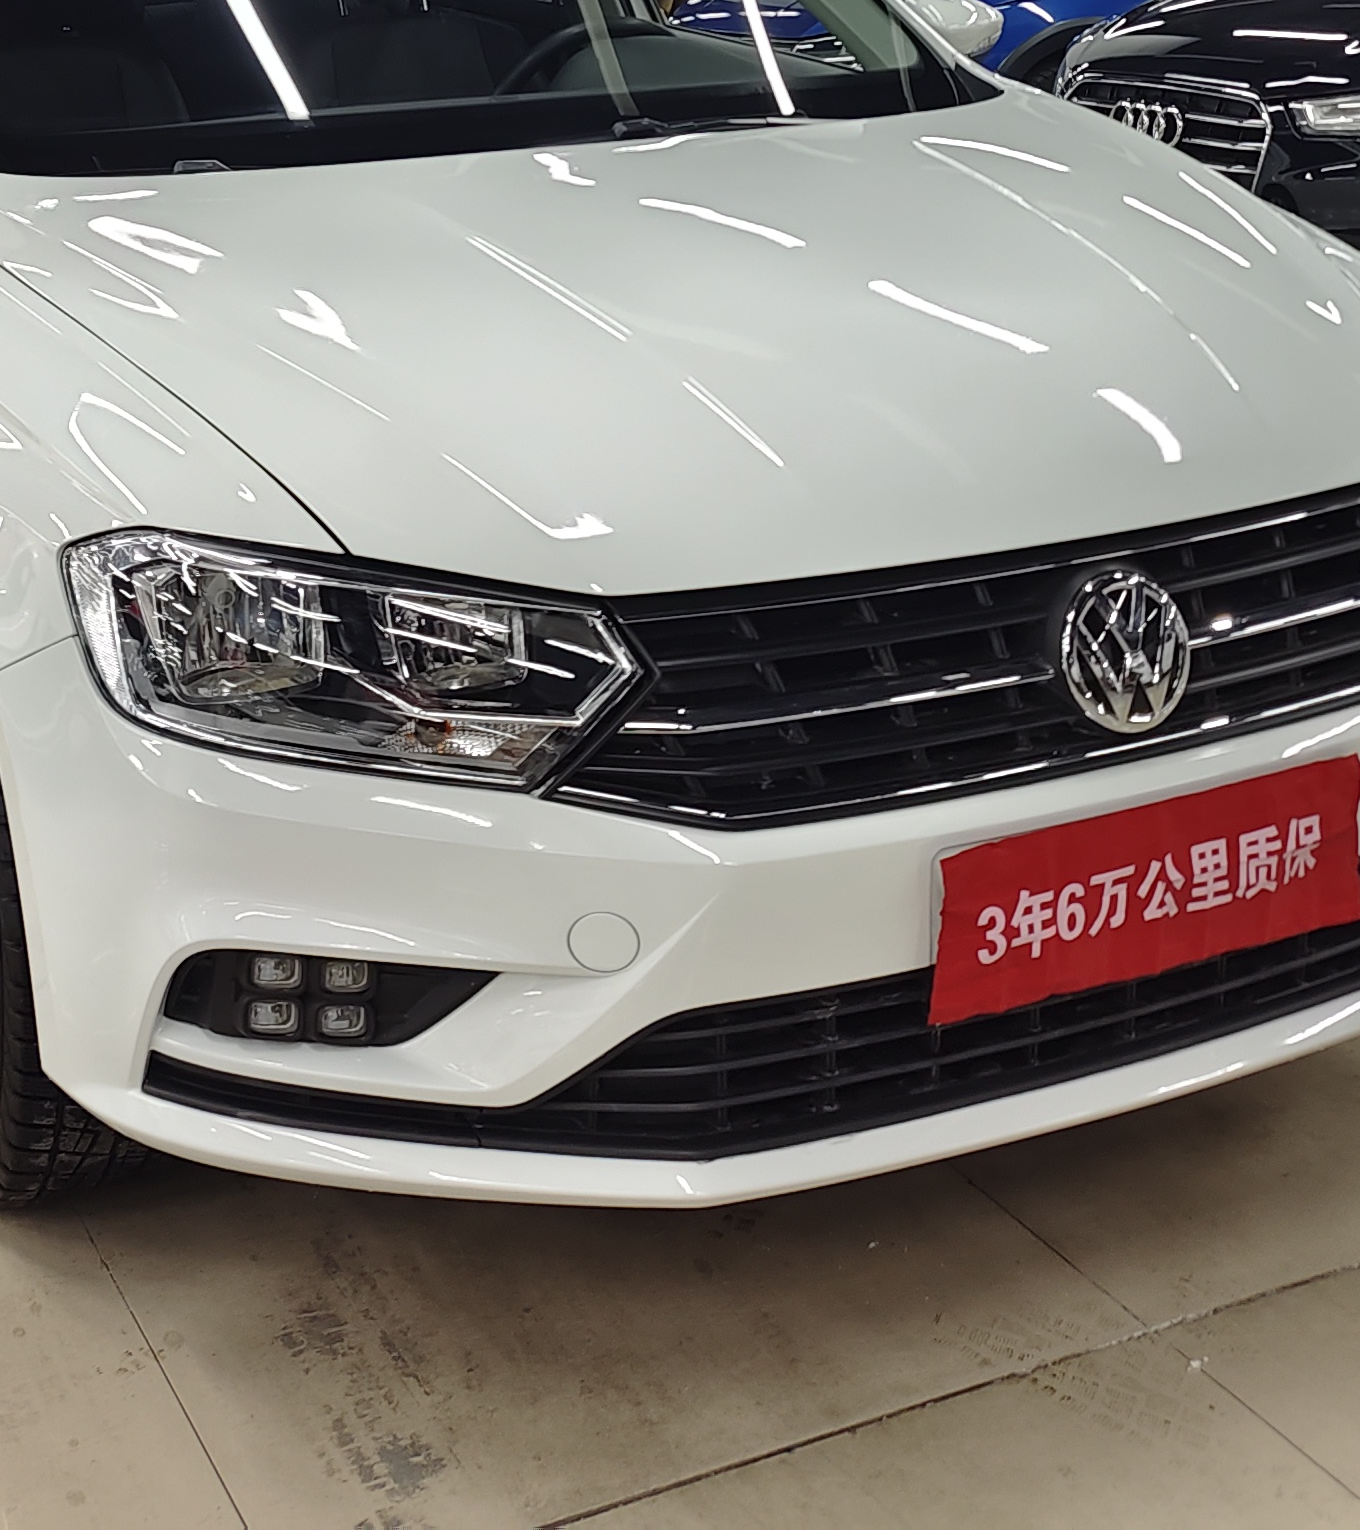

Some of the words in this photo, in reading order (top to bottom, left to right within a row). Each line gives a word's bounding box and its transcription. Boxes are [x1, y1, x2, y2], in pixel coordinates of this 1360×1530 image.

[976, 813, 1323, 965] 3年6万公里质保
